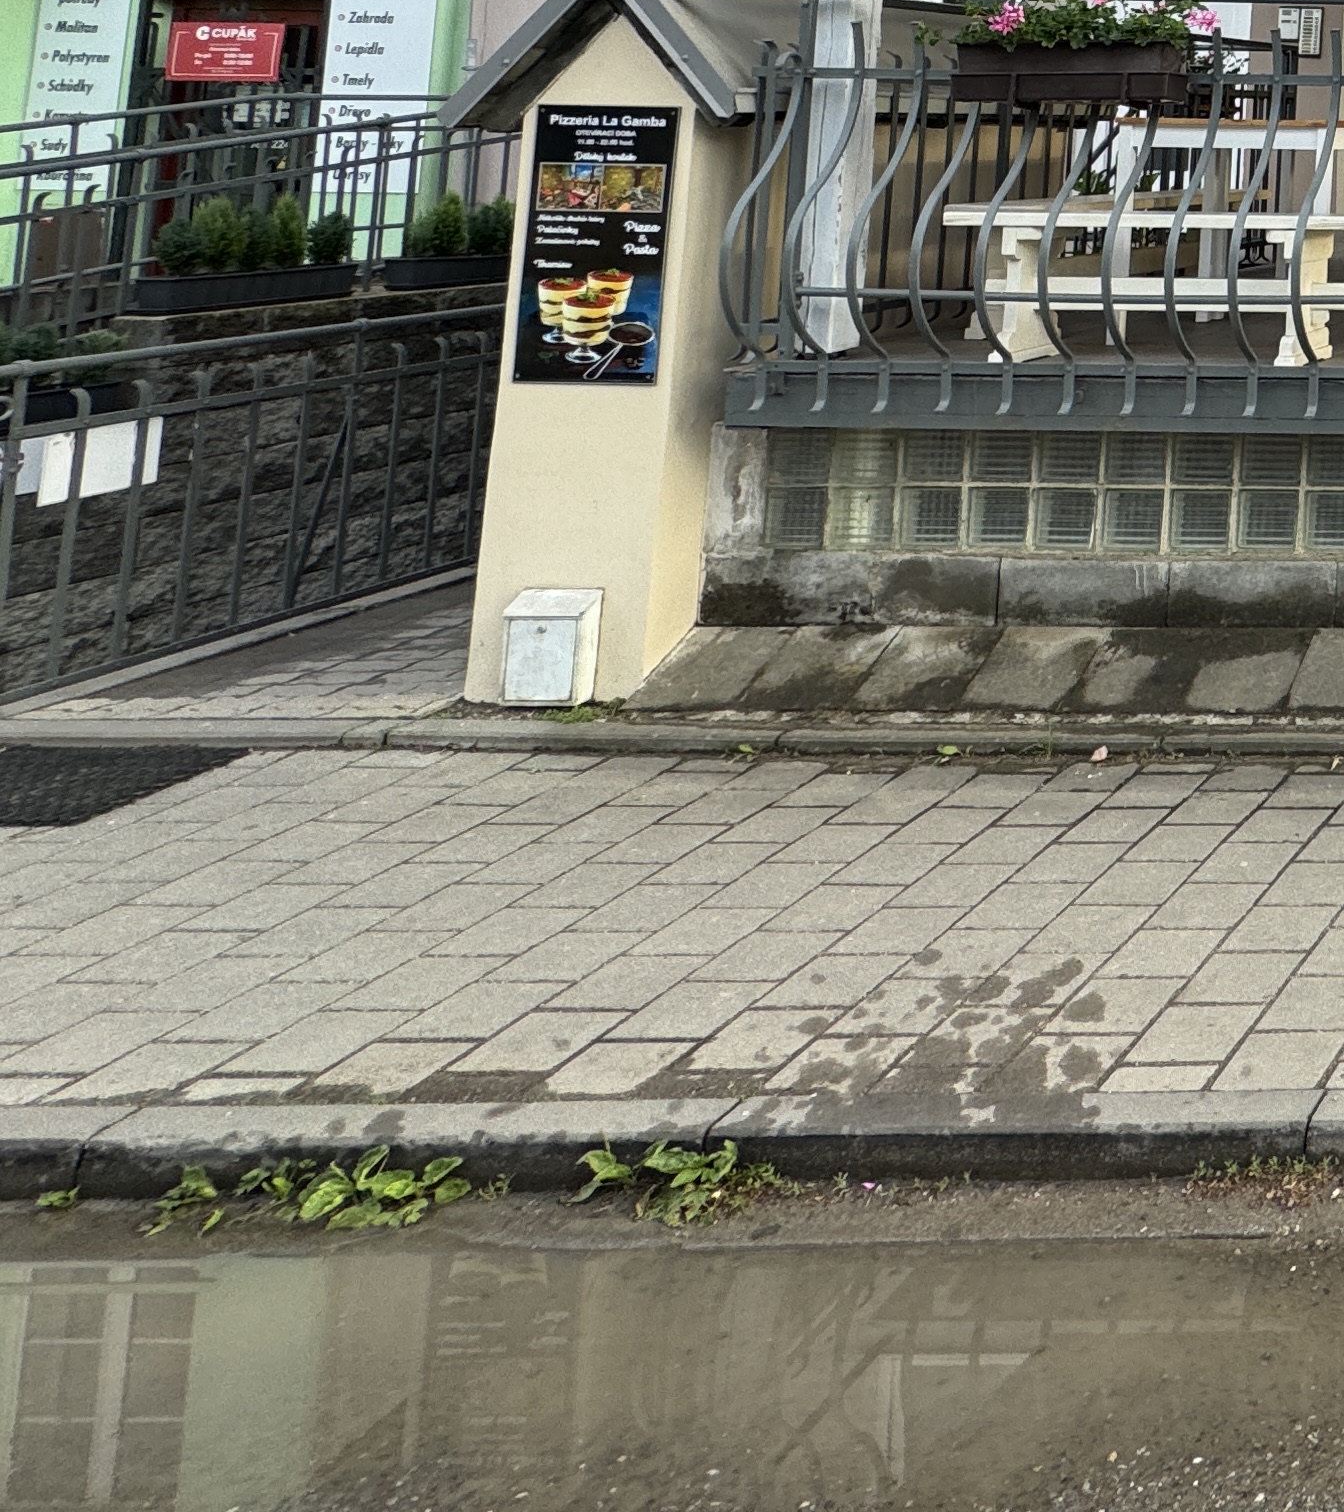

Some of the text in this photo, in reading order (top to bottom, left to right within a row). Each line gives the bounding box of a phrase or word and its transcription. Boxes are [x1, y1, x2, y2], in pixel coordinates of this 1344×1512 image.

[347, 10, 395, 25] Zahrada
[211, 25, 258, 39] CUPÁK
[344, 41, 386, 58] Lepidla
[51, 49, 111, 67] Polystyren
[46, 78, 95, 97] Schůdky
[341, 73, 376, 89] Tmely
[338, 104, 372, 118] Dřevo
[549, 113, 667, 128] Pizzeria La Gamba
[623, 220, 662, 234] Pizza
[622, 242, 661, 256] Pasta
